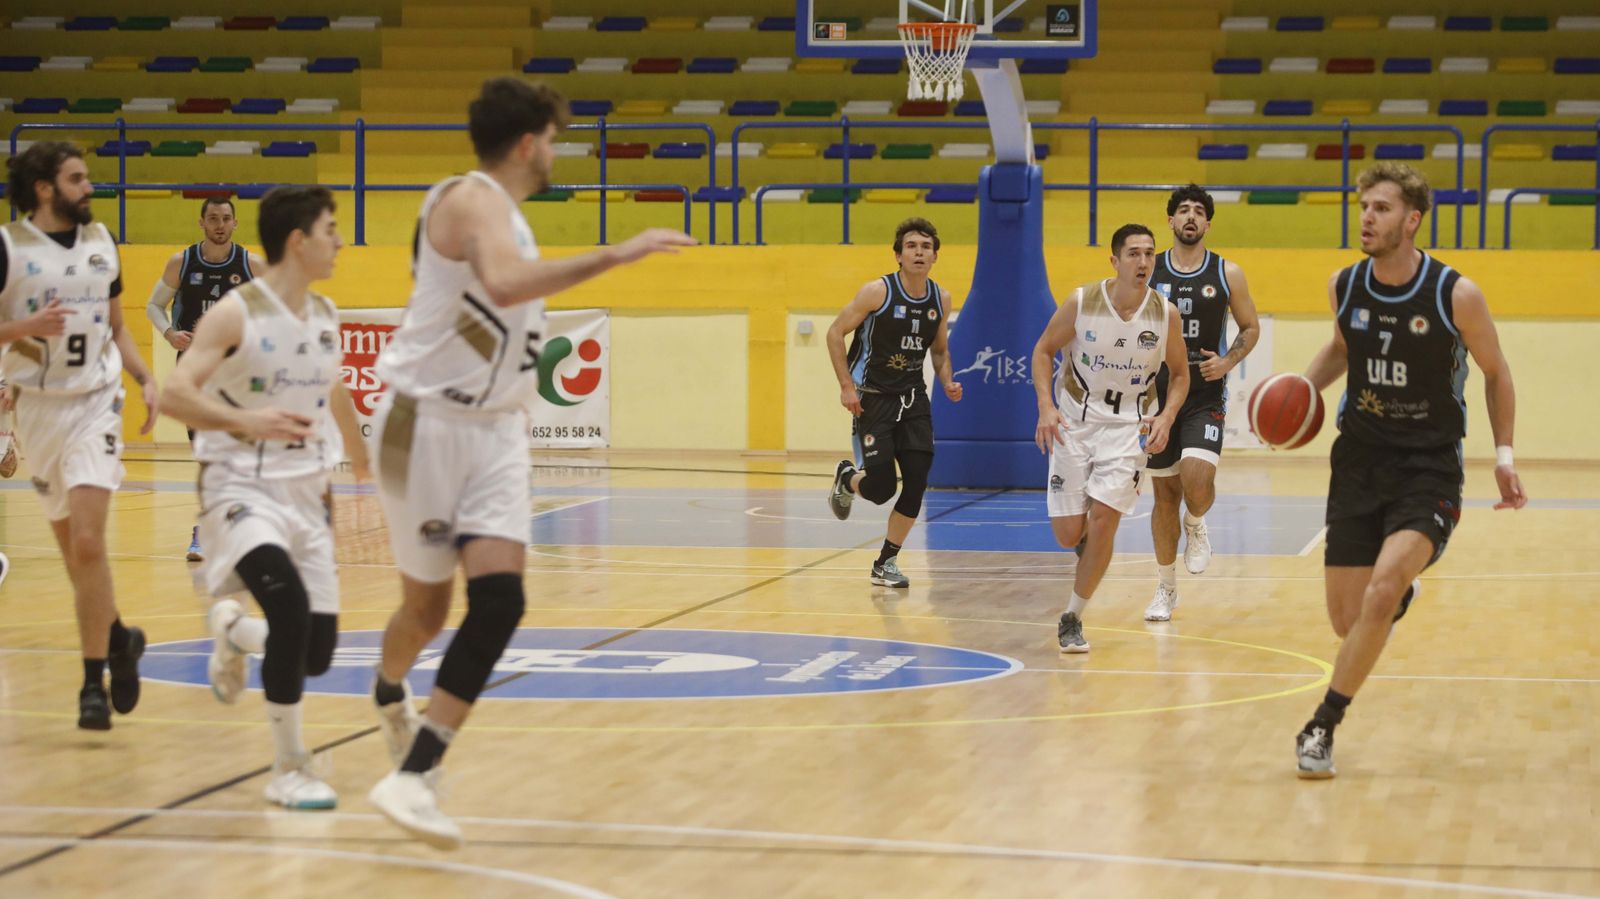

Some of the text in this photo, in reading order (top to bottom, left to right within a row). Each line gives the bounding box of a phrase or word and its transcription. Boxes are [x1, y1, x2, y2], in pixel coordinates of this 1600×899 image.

[210, 284, 220, 298] 4
[1177, 298, 1193, 315] 10
[1181, 319, 1200, 338] LB
[66, 333, 87, 367] 9
[901, 336, 924, 351] ULB
[1378, 330, 1393, 355] 7
[1366, 358, 1407, 387] ULB
[1104, 389, 1124, 415] 4
[532, 426, 601, 438] 652 95 58 24
[1204, 424, 1219, 442] 10
